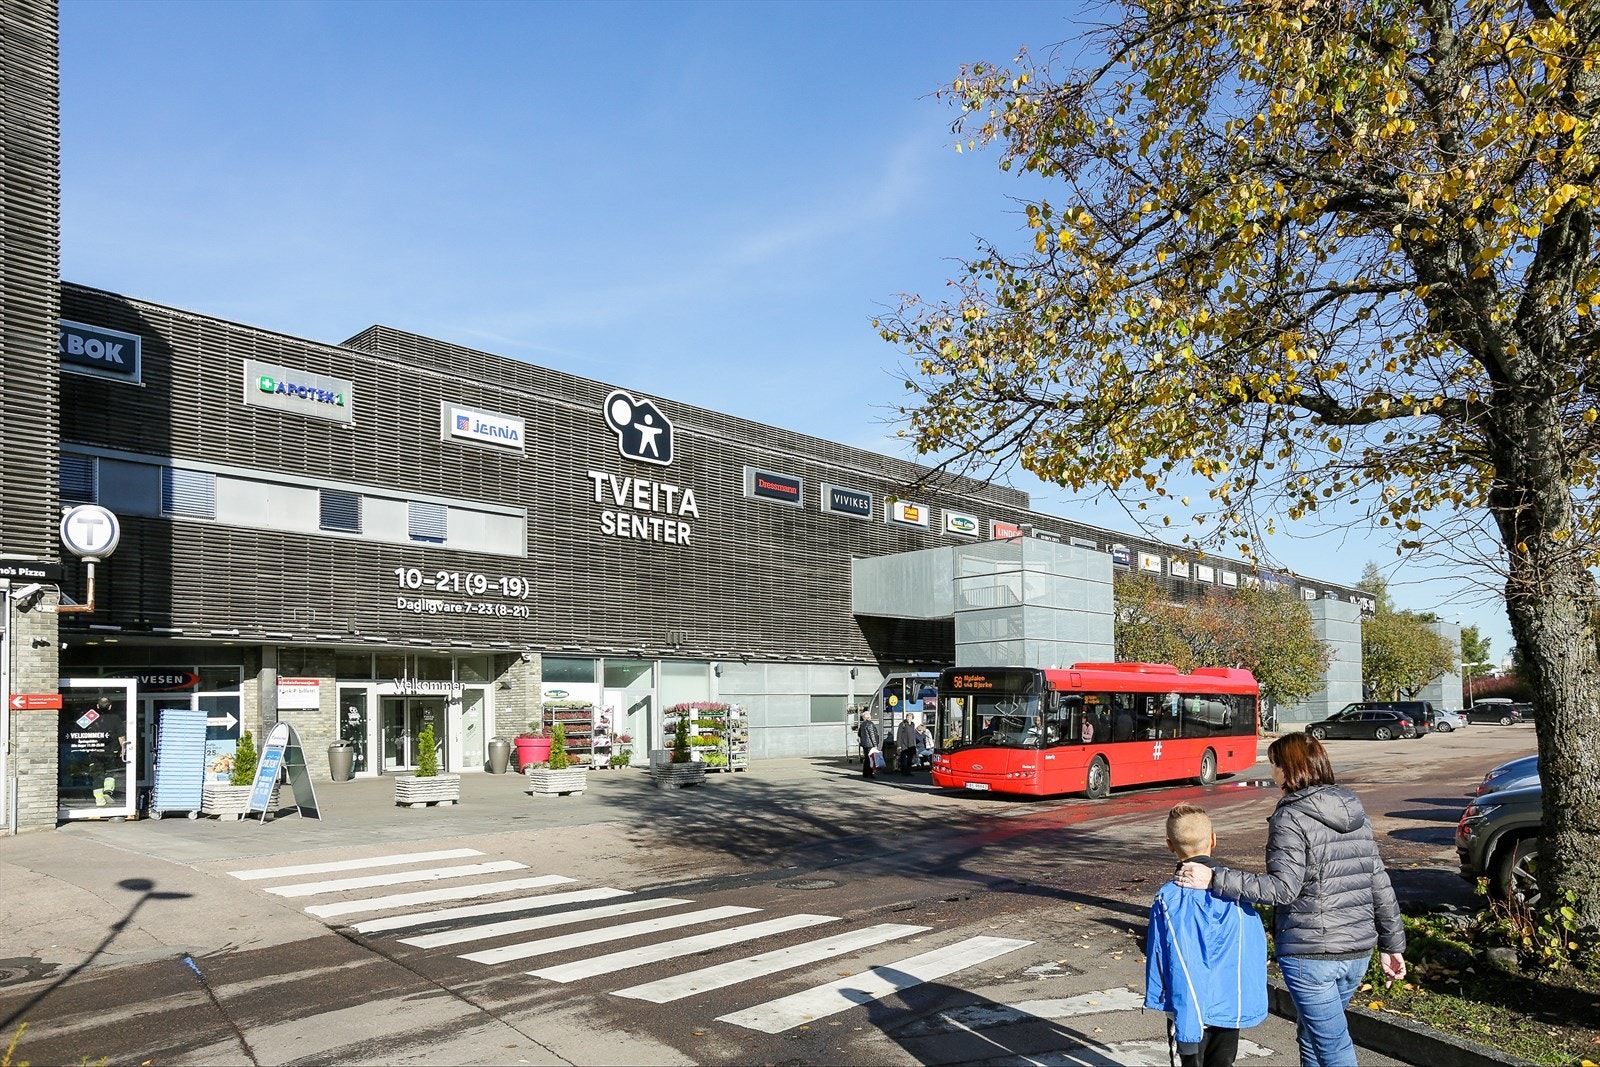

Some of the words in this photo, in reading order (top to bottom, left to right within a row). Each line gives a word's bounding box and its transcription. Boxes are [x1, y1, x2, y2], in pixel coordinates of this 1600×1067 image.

[275, 382, 334, 404] APOTEK
[336, 393, 344, 406] 1
[588, 470, 699, 518] TVEITA
[758, 479, 797, 494] Dressmann
[834, 493, 868, 509] VIVIKES
[77, 518, 103, 545] T
[601, 511, 690, 545] SENTER
[19, 568, 45, 576] Pizza
[397, 597, 462, 614] Dagligvare
[394, 677, 467, 690] Velkommen
[953, 676, 963, 688] 58
